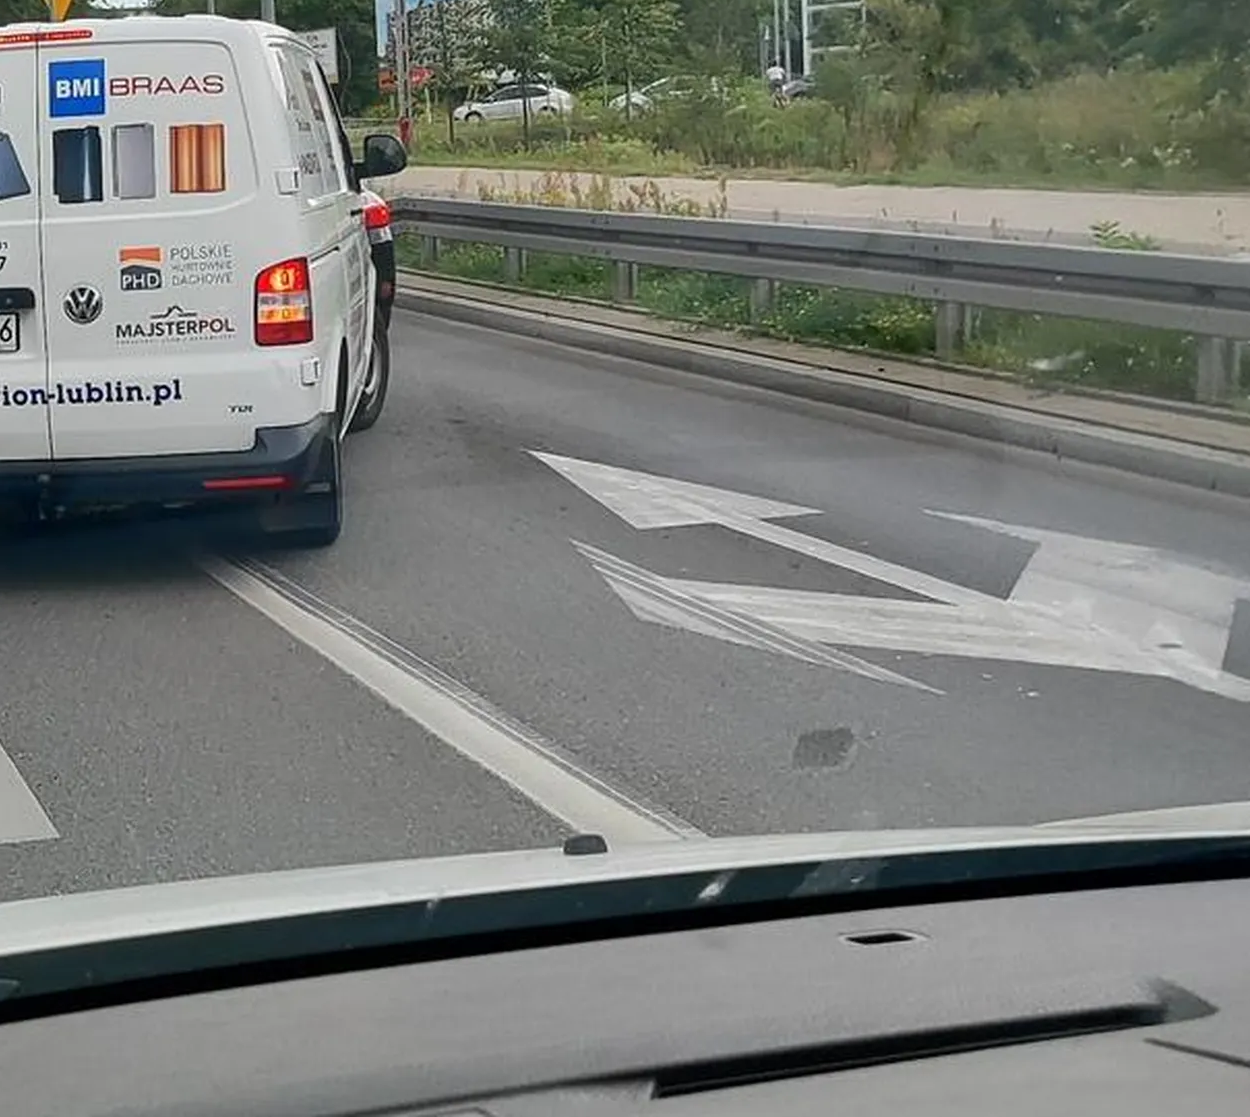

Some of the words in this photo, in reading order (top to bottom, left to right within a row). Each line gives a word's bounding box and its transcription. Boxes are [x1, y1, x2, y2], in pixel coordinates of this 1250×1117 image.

[56, 77, 100, 99] BMI
[109, 74, 224, 97] BRAAS
[170, 244, 232, 261] POLSKIE
[121, 272, 161, 290] PHD
[116, 318, 235, 338] MAJSTERPOL
